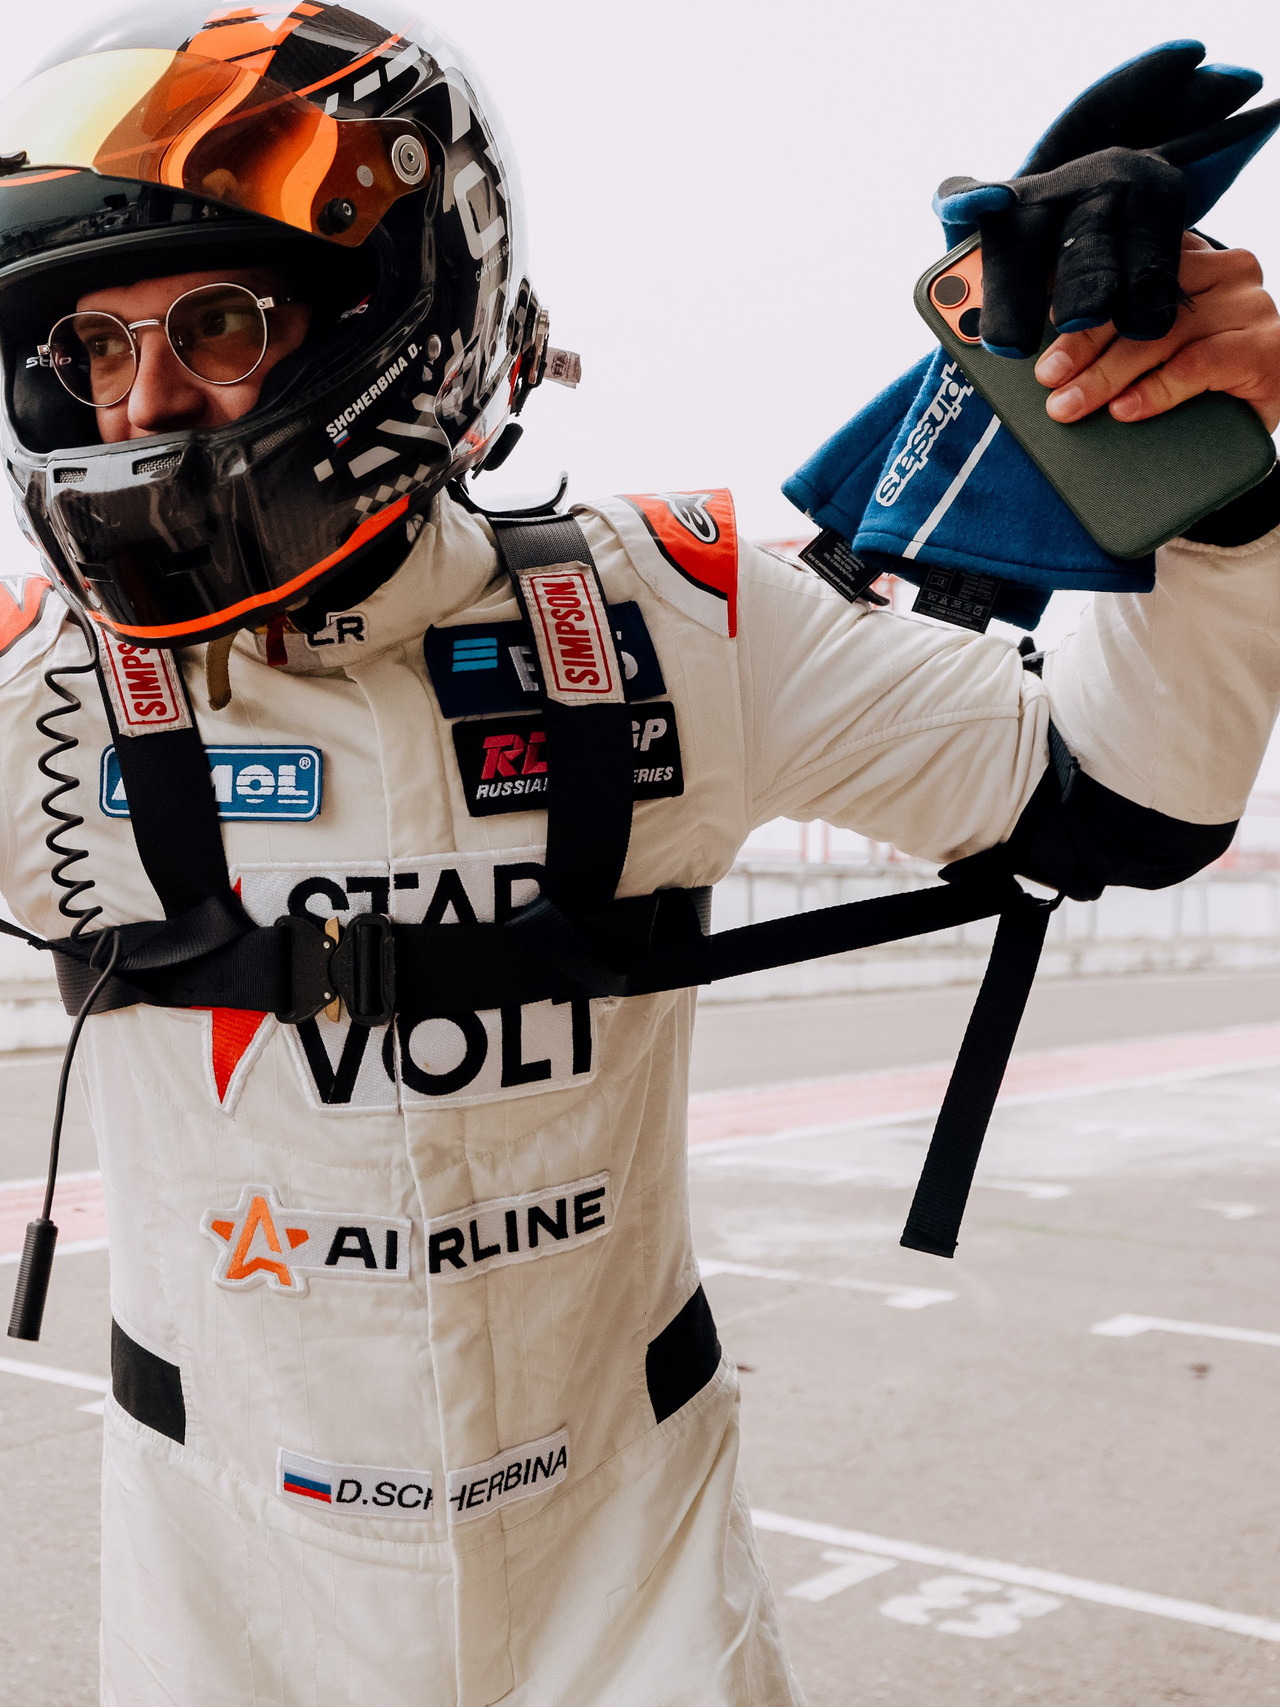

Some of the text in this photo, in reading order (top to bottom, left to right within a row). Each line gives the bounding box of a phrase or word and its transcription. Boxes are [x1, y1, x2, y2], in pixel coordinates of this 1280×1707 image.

[326, 343, 422, 438] SHCHERBINA D.
[542, 581, 600, 686] SIMPSON
[117, 642, 167, 717] SIMPS
[633, 766, 674, 783] ERIES
[296, 998, 593, 1104] VOLT
[325, 1187, 606, 1273] AIRLINE
[785, 1550, 1063, 1639] 18
